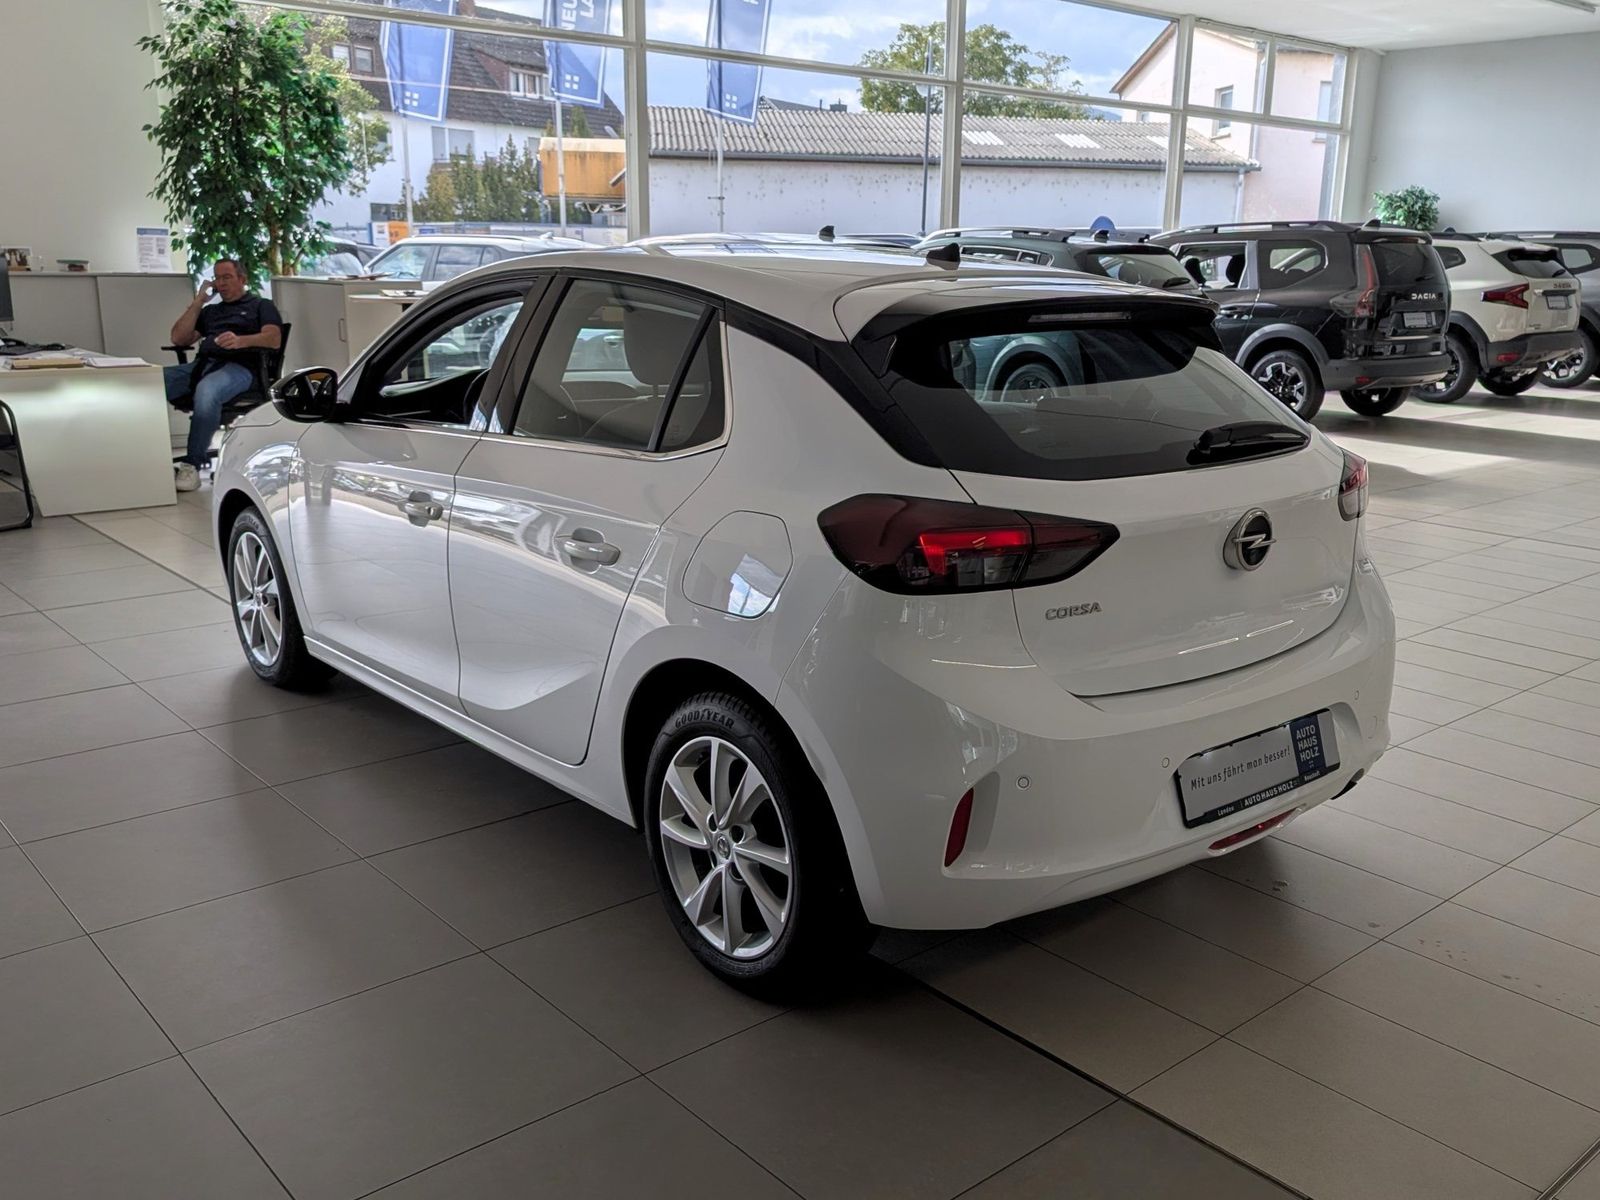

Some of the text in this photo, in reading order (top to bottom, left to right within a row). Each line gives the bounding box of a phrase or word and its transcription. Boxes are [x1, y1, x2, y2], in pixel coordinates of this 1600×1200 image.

[1411, 292, 1437, 301] DACIA
[1045, 602, 1102, 620] CORSA
[675, 709, 735, 729] GOODYEAR
[1296, 725, 1316, 739] AUTO
[1298, 736, 1318, 750] HAUS
[1300, 747, 1320, 762] HOLZ
[1191, 745, 1291, 790] Mit uns fährt man besser!
[1278, 781, 1294, 793] HOLZ
